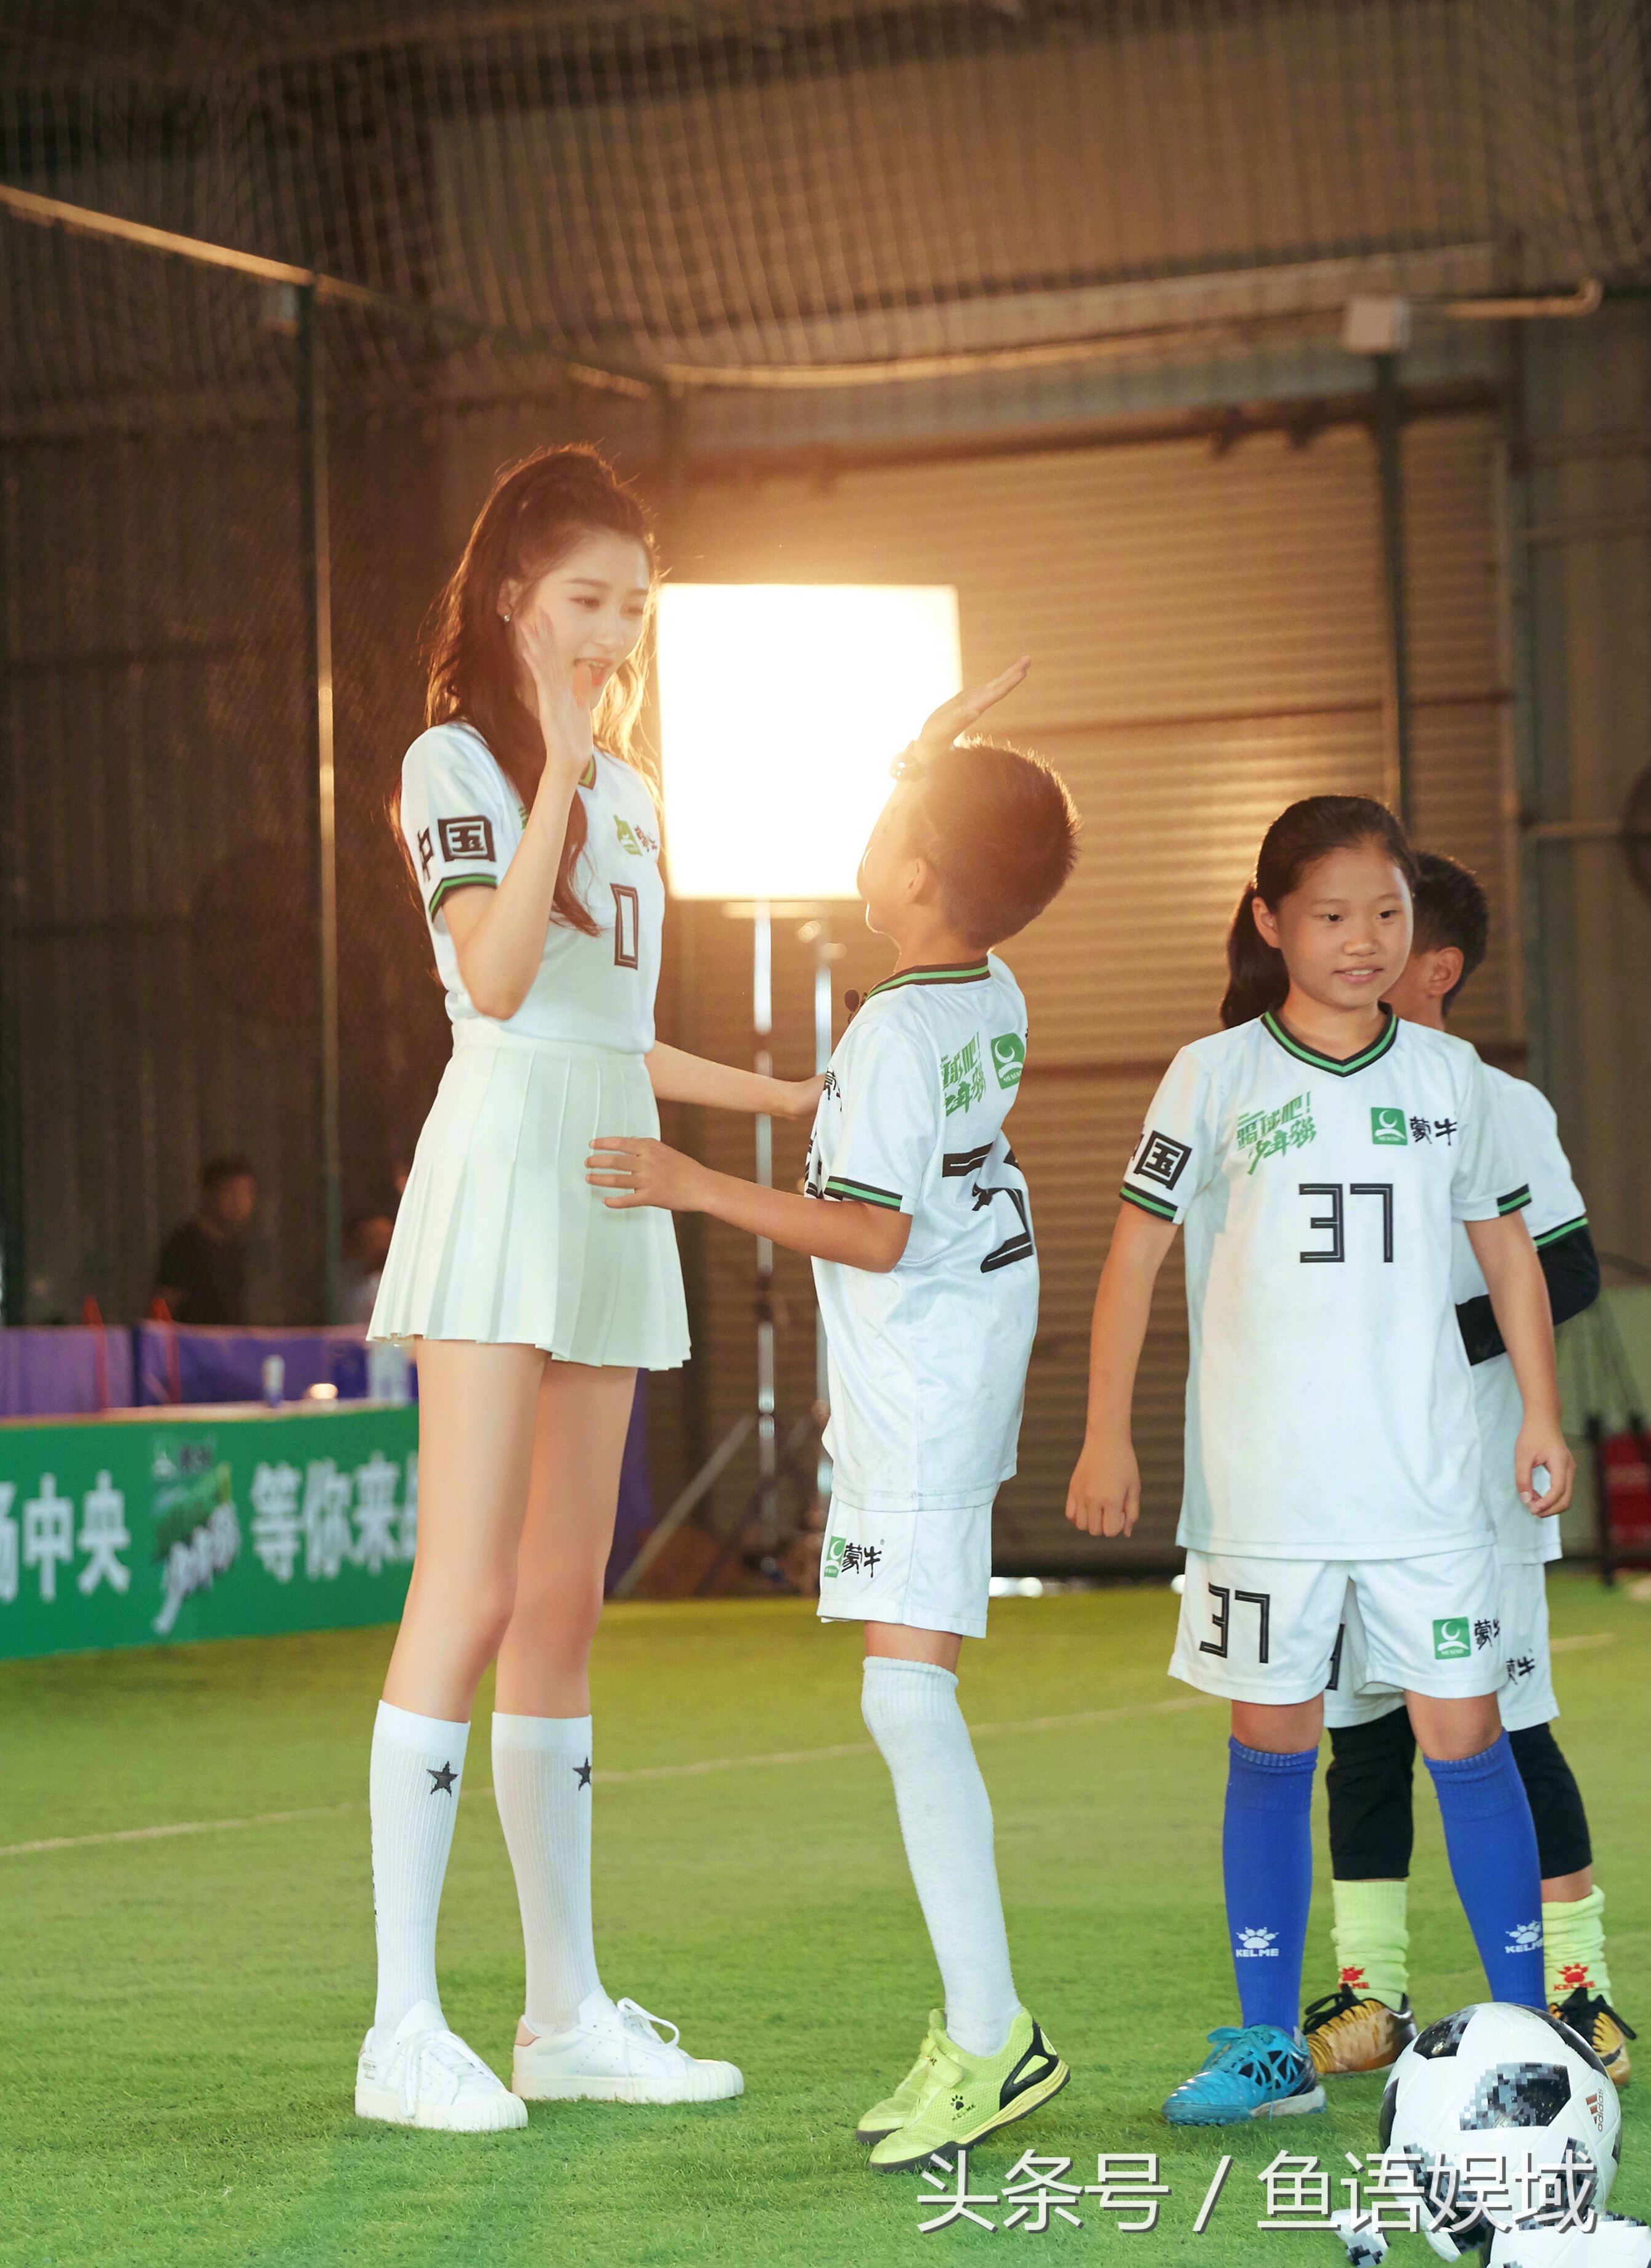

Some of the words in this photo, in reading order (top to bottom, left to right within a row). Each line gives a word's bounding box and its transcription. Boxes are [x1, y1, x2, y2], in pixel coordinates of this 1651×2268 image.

[418, 815, 497, 883] 中国
[1133, 1130, 1192, 1191] 国
[1409, 1116, 1457, 1146] 蒙牛
[1298, 1183, 1393, 1263] 37
[251, 1450, 420, 1583] 等你来
[841, 1543, 882, 1578] 蒙牛
[1199, 1581, 1270, 1663] 37
[1235, 1948, 1279, 1957] KELME
[1504, 1937, 1543, 1954] KELM
